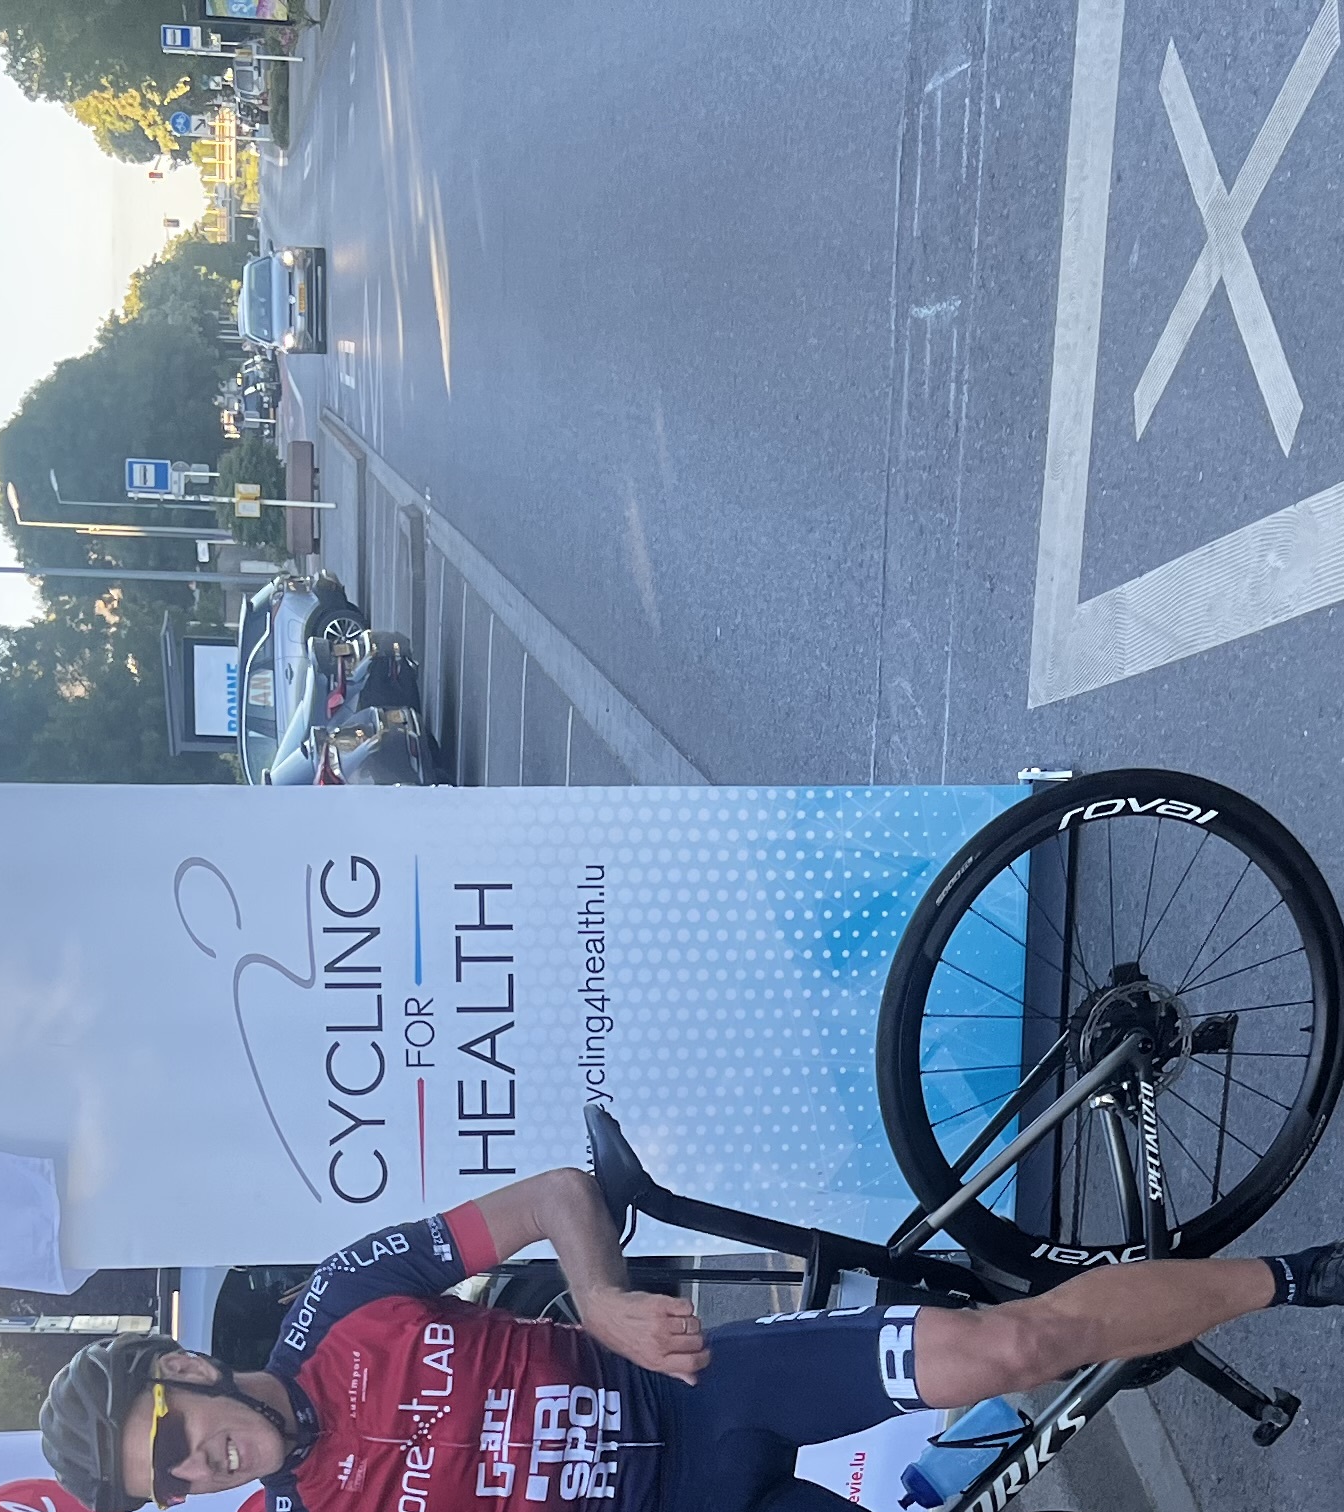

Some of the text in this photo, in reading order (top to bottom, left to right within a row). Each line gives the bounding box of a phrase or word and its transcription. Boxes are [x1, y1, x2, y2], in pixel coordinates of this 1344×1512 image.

[1057, 797, 1219, 830] roval
[320, 855, 388, 1204] CYCLING
[404, 996, 435, 1067] FOR
[454, 883, 517, 1175] HEALTH
[577, 864, 614, 1174] ycling4health.lu
[1140, 1081, 1163, 1201] SPECIALIZED
[529, 1384, 570, 1474] TRI
[559, 1384, 599, 1501] SPO
[586, 1429, 618, 1498] RT
